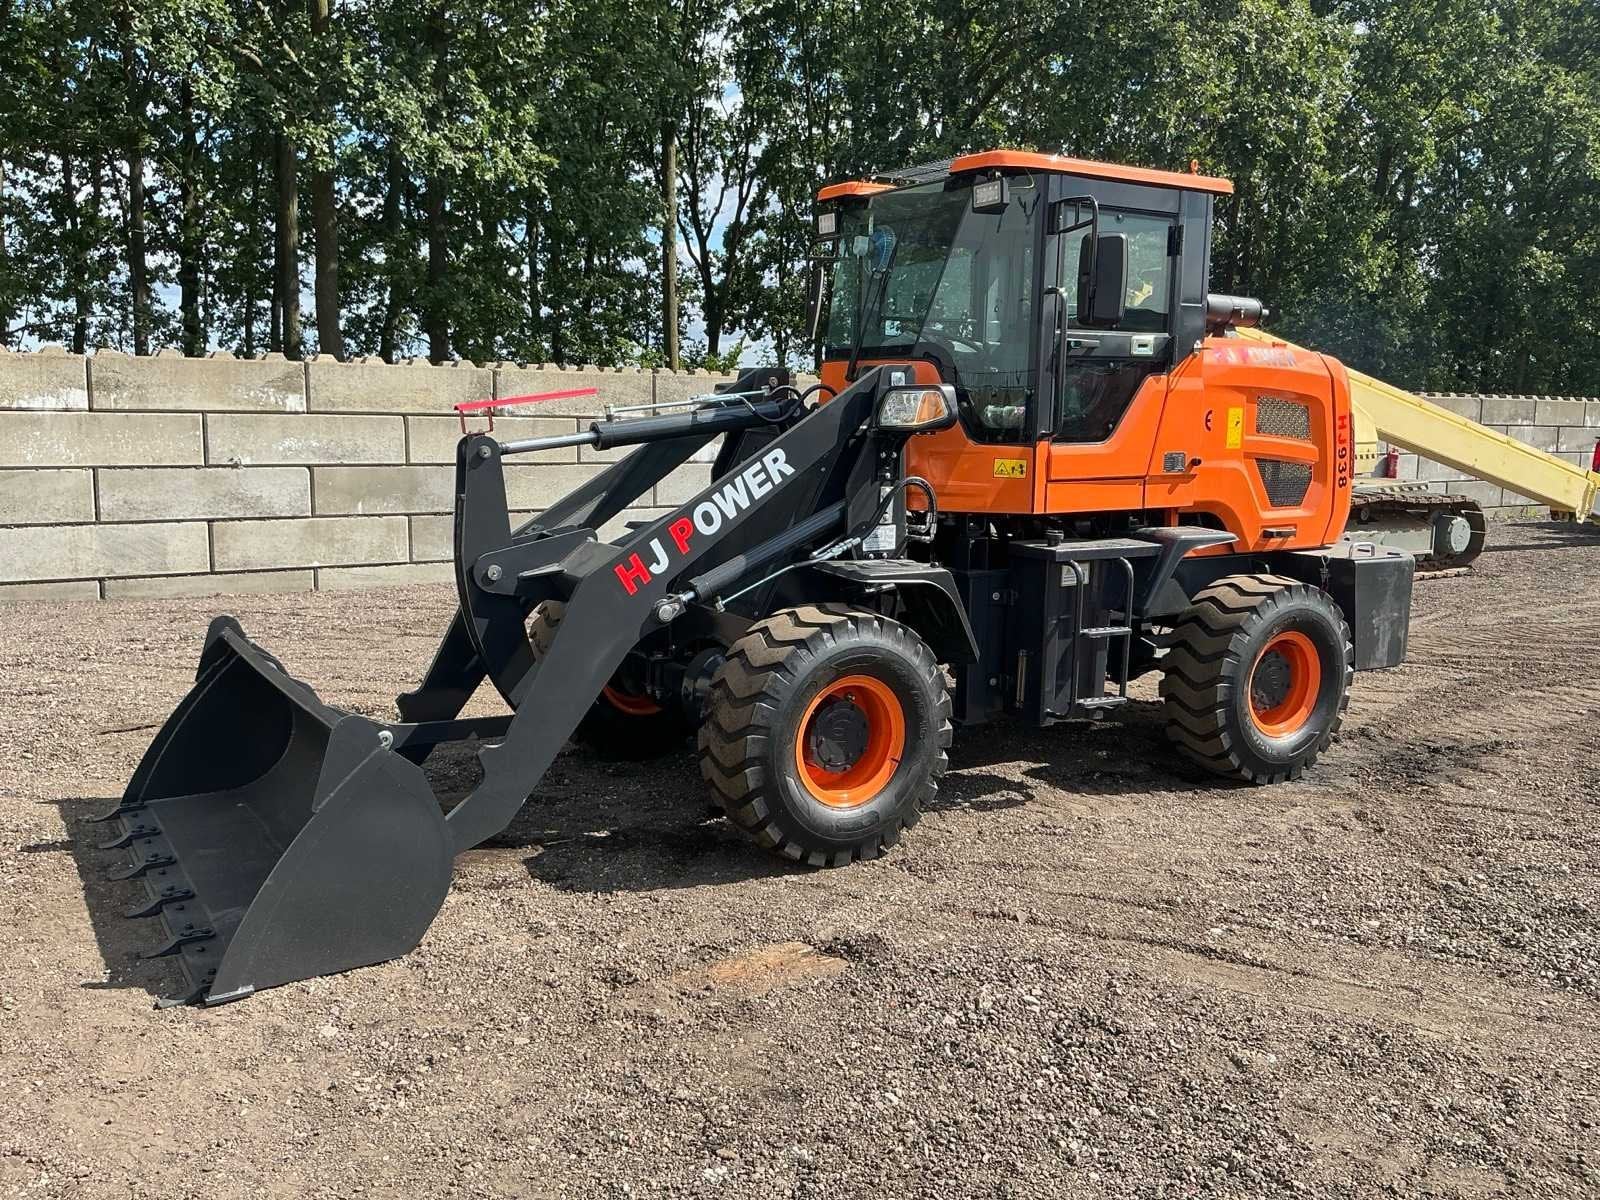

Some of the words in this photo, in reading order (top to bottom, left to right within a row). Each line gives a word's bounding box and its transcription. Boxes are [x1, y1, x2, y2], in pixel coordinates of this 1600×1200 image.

[1338, 415, 1348, 488] HJ938
[613, 537, 670, 596] HJ
[667, 448, 796, 555] POWER
